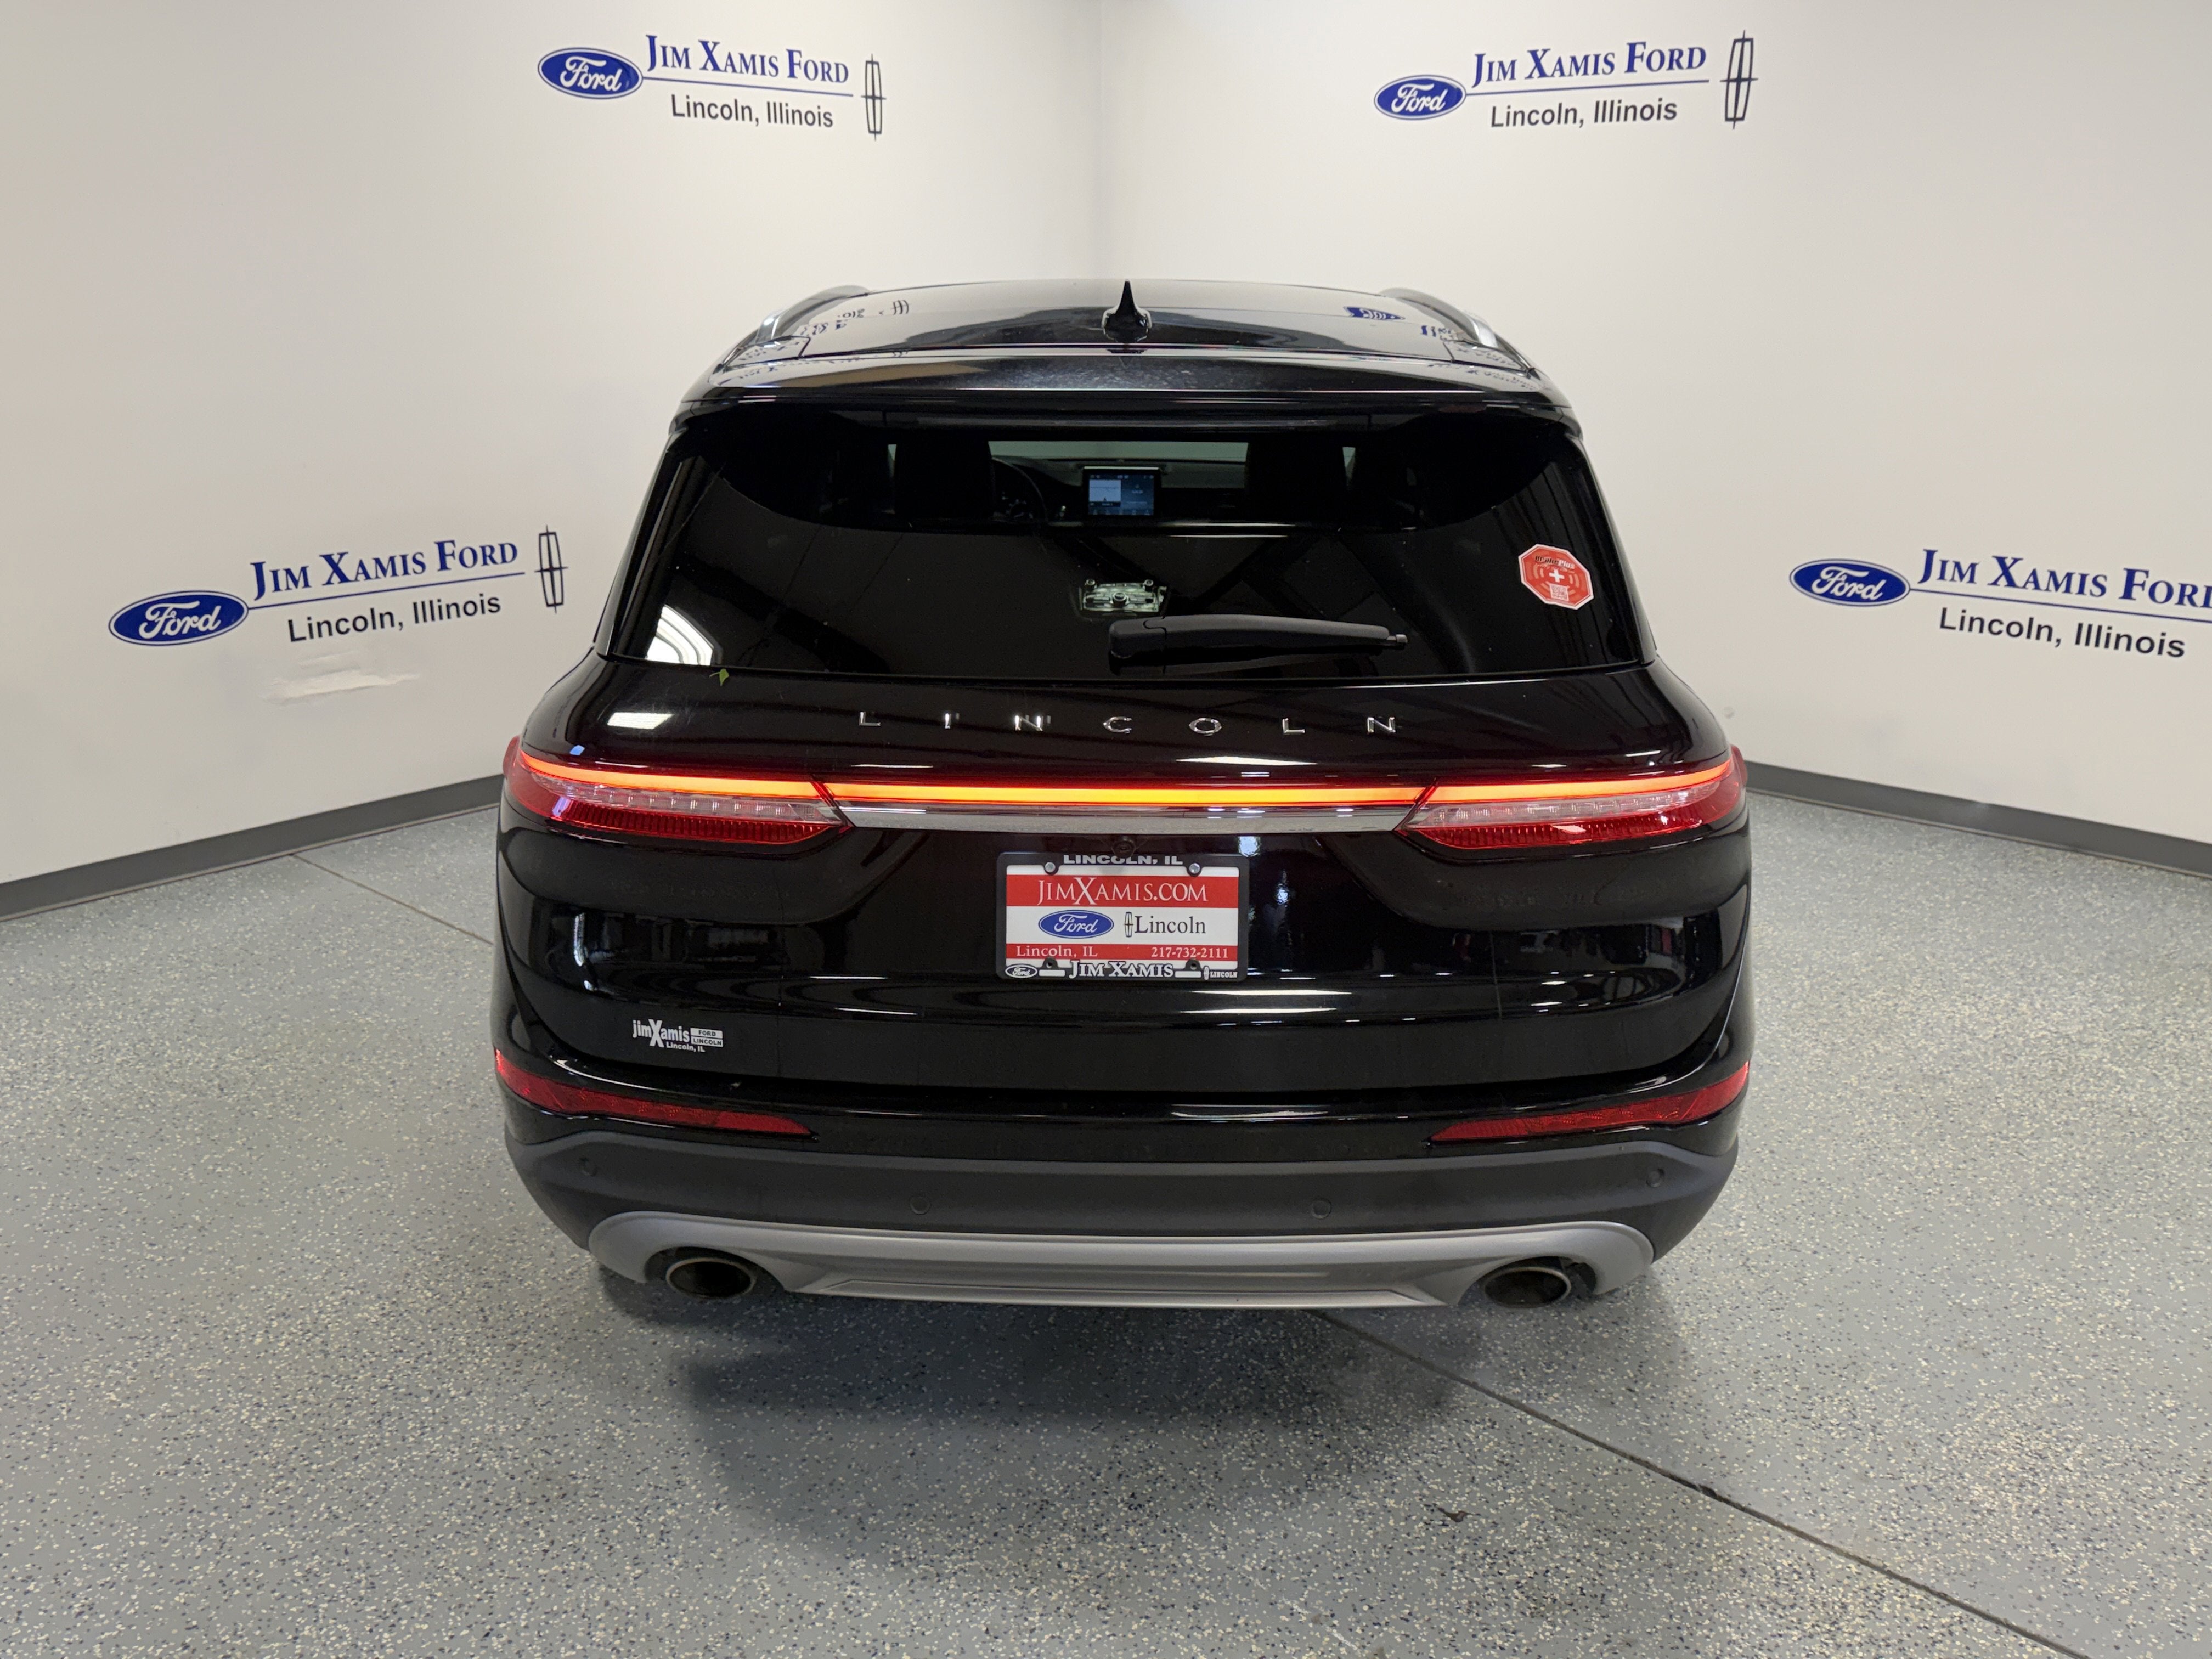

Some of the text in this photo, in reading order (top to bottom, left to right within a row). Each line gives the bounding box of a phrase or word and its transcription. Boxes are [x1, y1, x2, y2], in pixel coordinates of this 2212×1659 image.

[560, 56, 623, 92] Ford
[646, 35, 848, 83] JIM XAMIS FORD
[1471, 42, 1706, 88] JIM XAMIS FORD
[672, 94, 833, 127] Lincoln, Illinois
[1392, 82, 1447, 112] Ford
[1491, 98, 1677, 128] Lincoln, Illinois
[251, 540, 518, 600] JIM XAMIS FORD
[1812, 566, 1886, 601] Ford
[1917, 549, 1980, 584] JIM
[1988, 555, 2108, 599] XAMIS
[138, 601, 221, 640] Ford
[287, 592, 501, 642] Lincoln, Illinois
[1939, 607, 2186, 658] Lincoln, Illinois
[859, 712, 1396, 735] LINCOLN
[1164, 856, 1183, 865] IL
[1036, 877, 1208, 906] JIMXAMIS.COM
[1053, 914, 1206, 934] Ford Lincoln
[1017, 945, 1098, 958] Lincoln, IL
[1151, 947, 1228, 958] 217-732-2111
[1012, 967, 1031, 976] Ford
[1069, 960, 1173, 979] JIM XAMIS
[666, 1041, 696, 1052] Lincoln,
